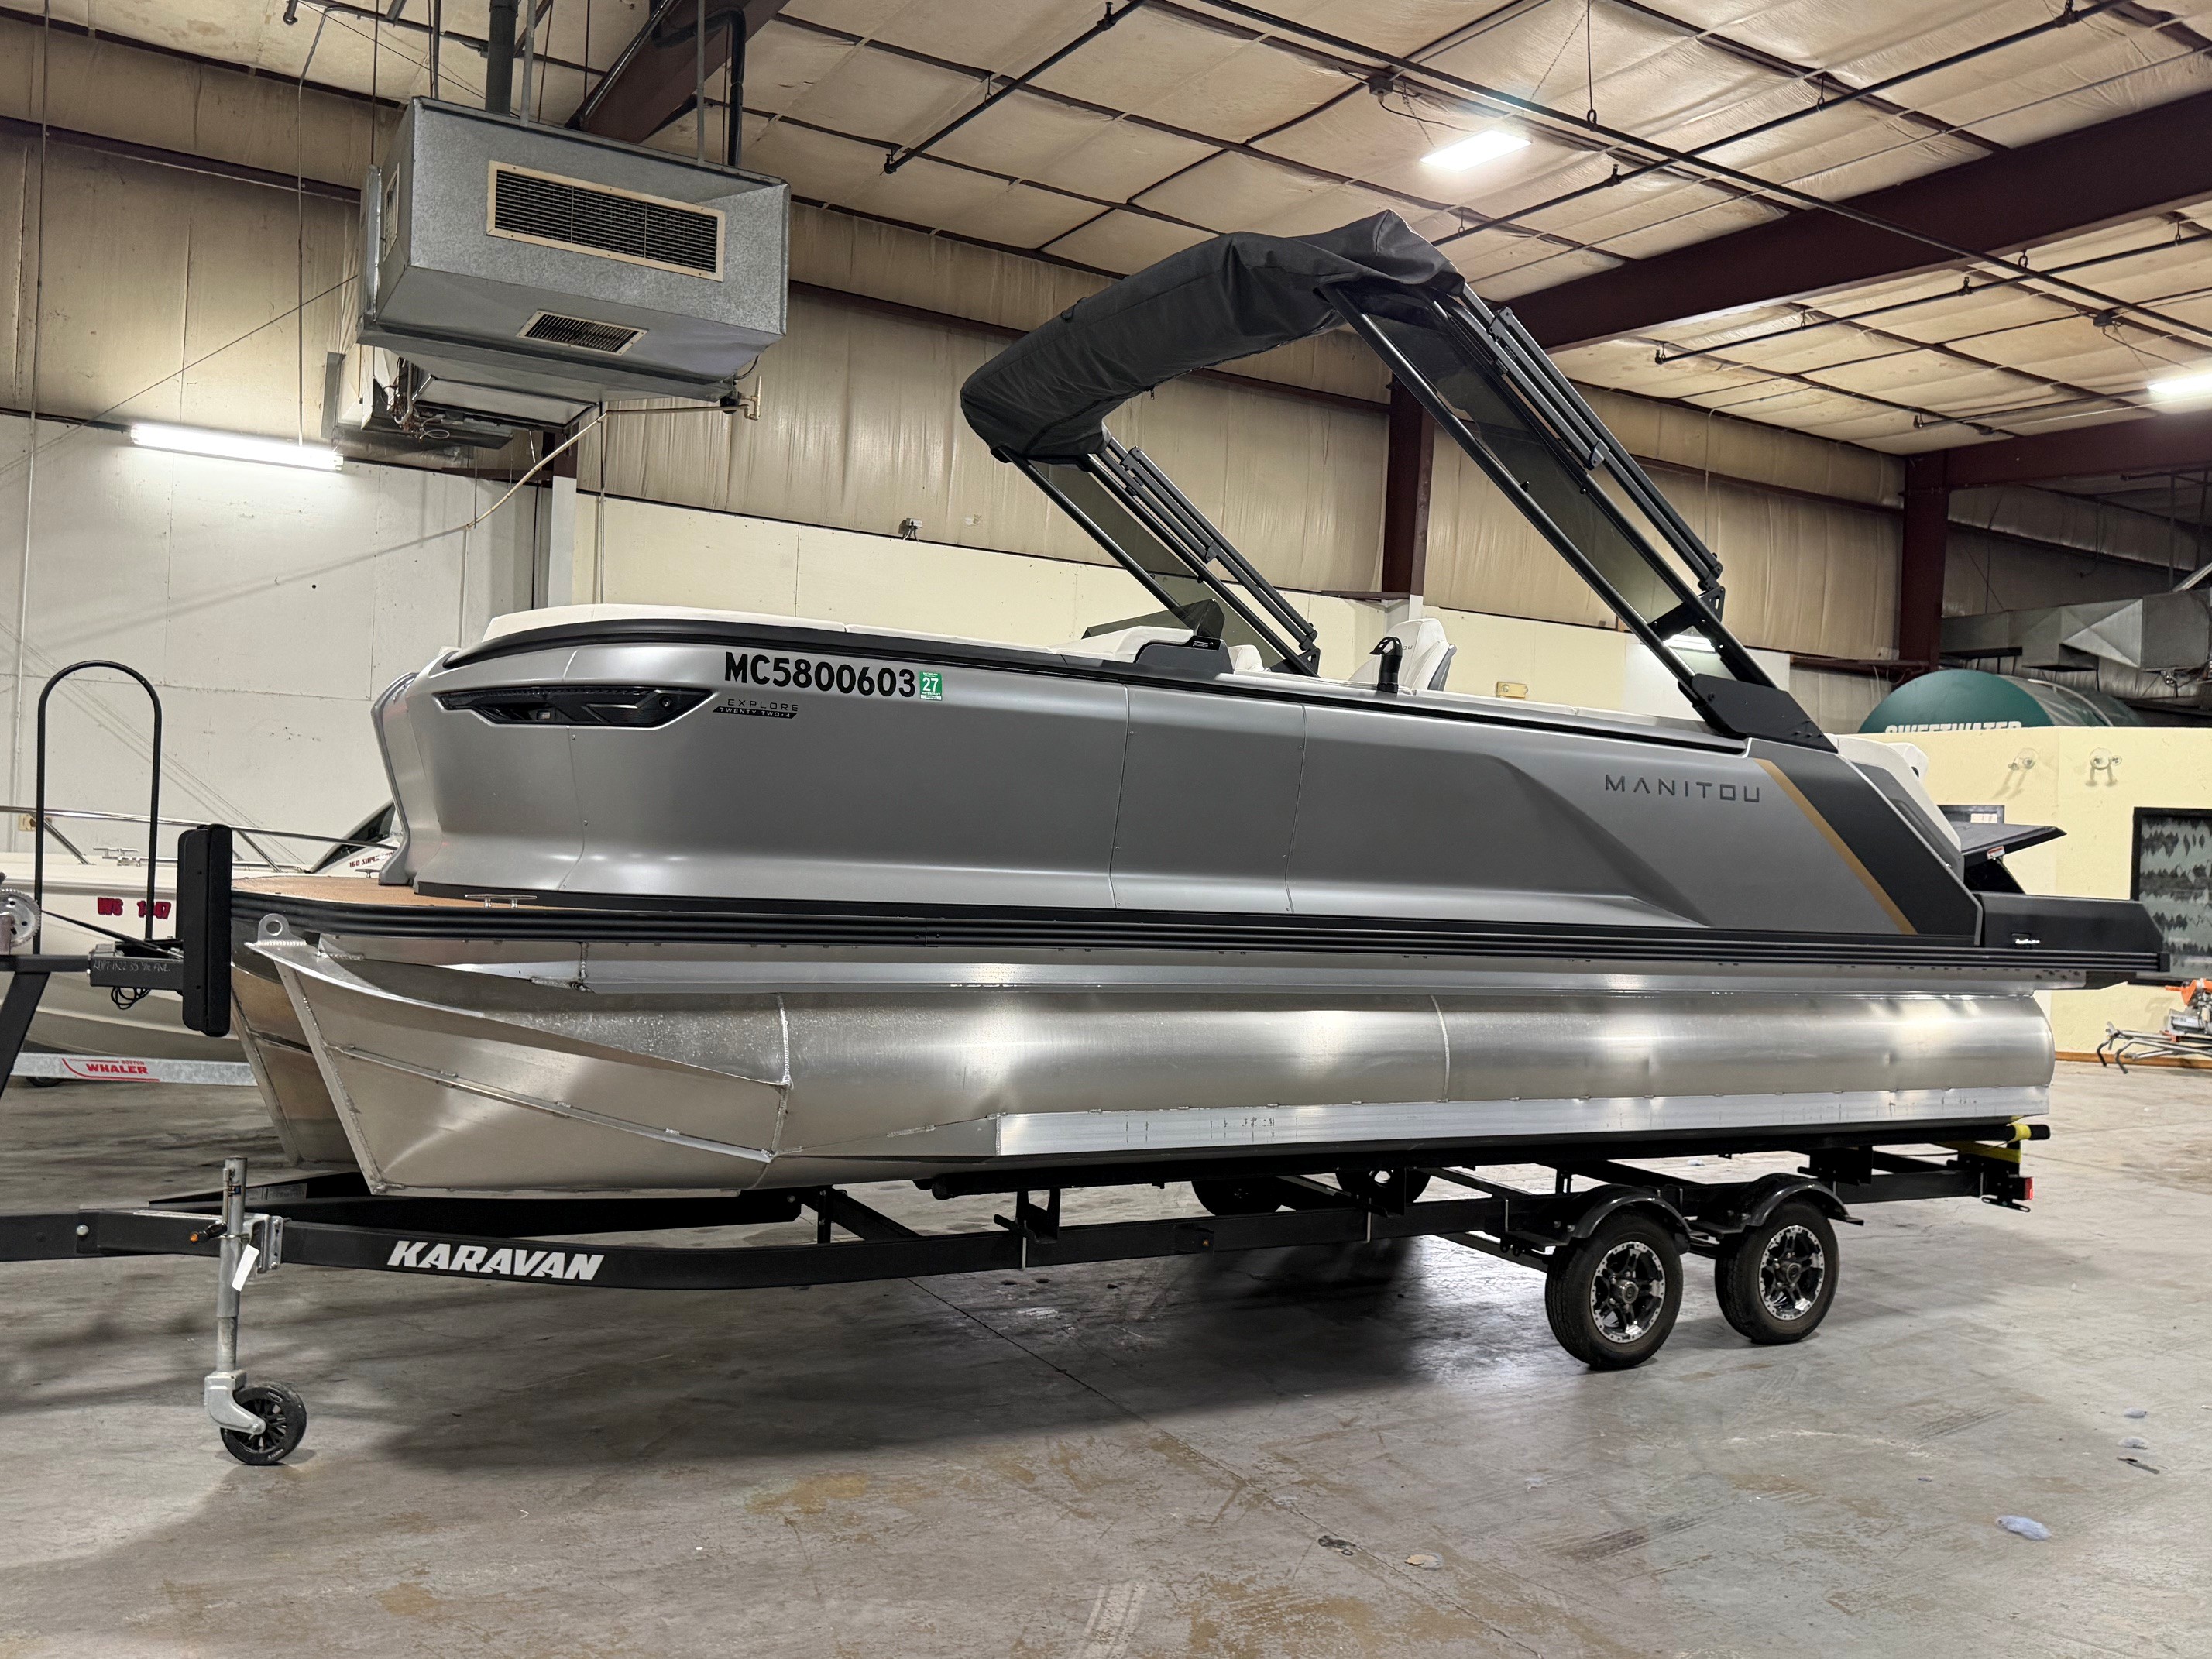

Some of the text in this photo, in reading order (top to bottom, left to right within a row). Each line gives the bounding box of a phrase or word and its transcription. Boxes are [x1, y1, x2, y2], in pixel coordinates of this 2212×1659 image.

[724, 651, 915, 697] MC5800603
[922, 677, 939, 692] 27
[728, 699, 798, 711] EXPLORE
[1605, 774, 1760, 802] MANITOU
[86, 1063, 149, 1074] WHALER
[387, 1240, 604, 1280] KARAVAN
